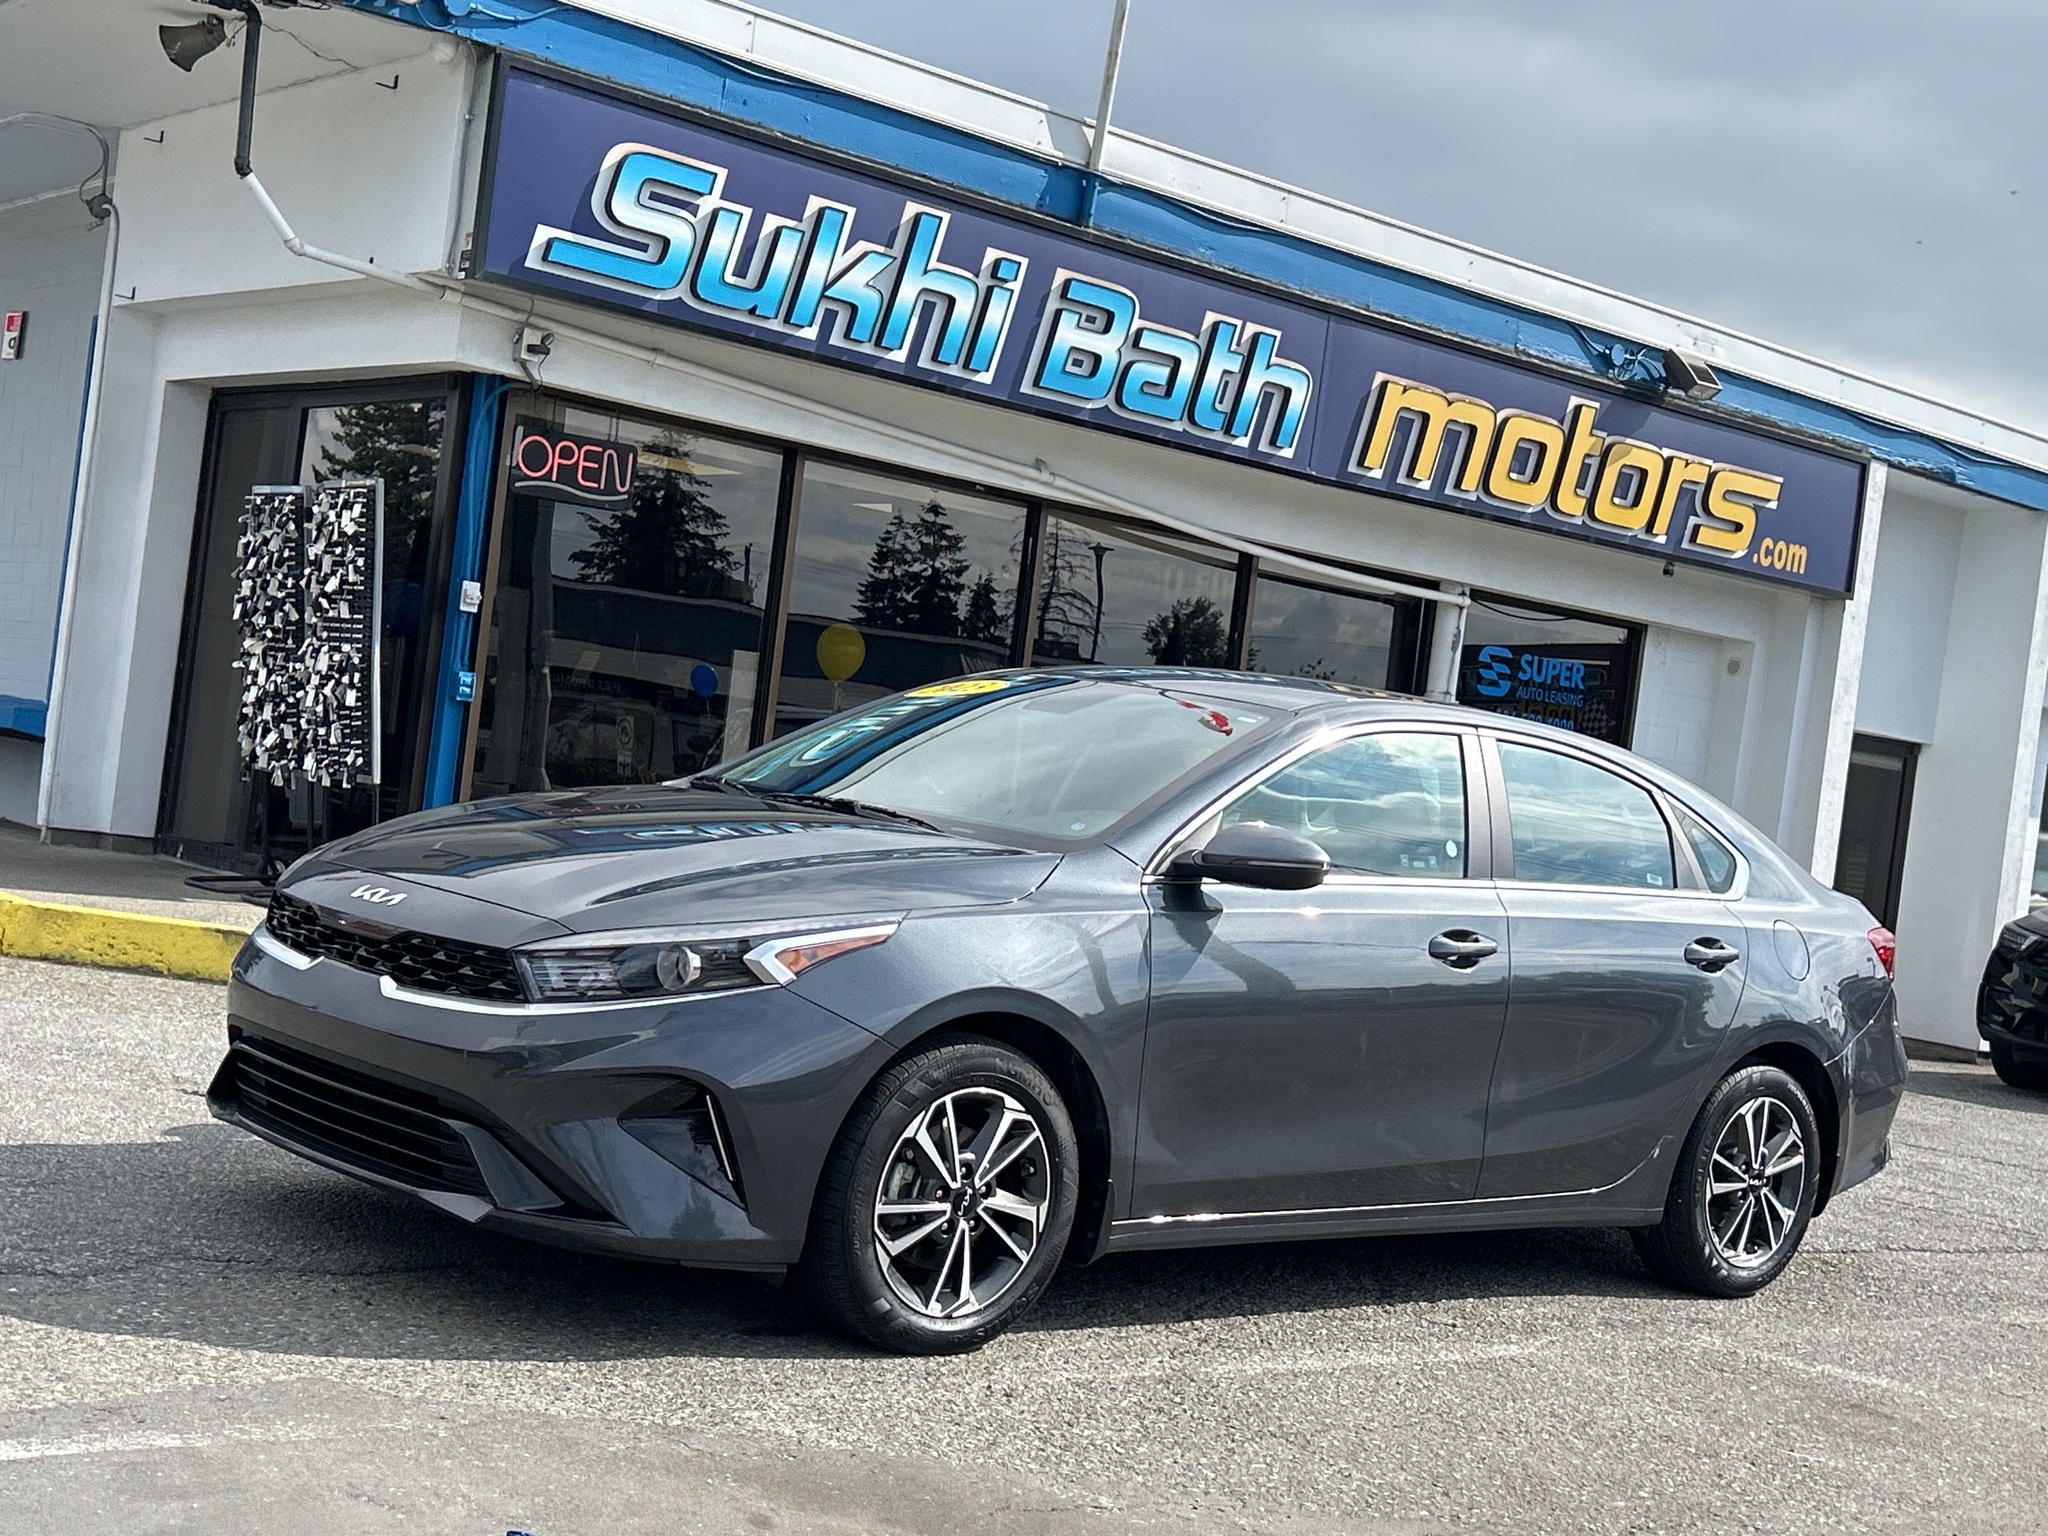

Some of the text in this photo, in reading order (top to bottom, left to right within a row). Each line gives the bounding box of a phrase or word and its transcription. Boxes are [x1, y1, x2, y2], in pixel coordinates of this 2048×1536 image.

[525, 143, 1029, 384] Sukhi
[1019, 267, 1313, 459] Bath
[1348, 371, 1784, 559] motors
[517, 435, 634, 493] OPEN
[1517, 653, 1585, 690] SUPER
[1516, 686, 1584, 708] AUTO LEASING
[350, 884, 408, 907] KIA
